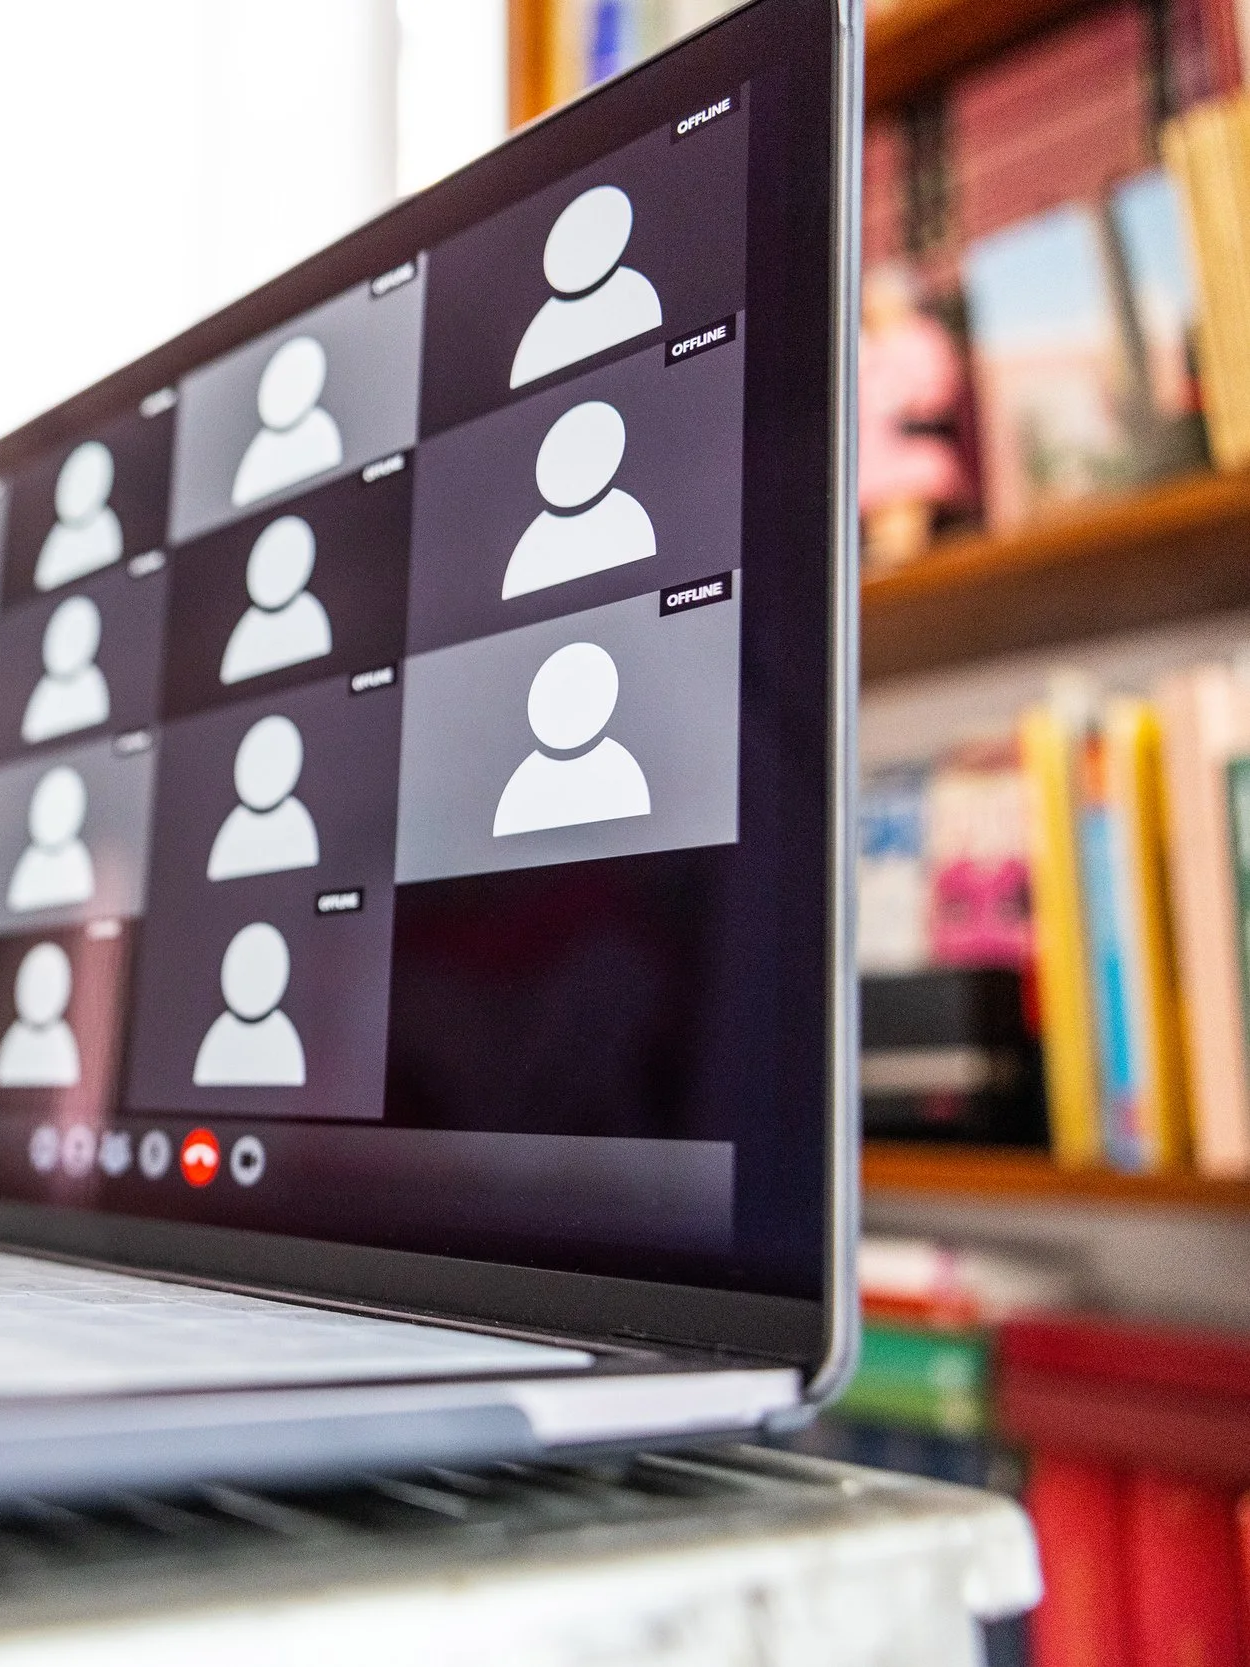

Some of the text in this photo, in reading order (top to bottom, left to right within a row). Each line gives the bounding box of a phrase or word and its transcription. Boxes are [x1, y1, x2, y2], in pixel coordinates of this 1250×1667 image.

[676, 97, 732, 135] OFFLINE
[671, 325, 727, 357] OFFLINE
[666, 581, 724, 608] OFFLINE
